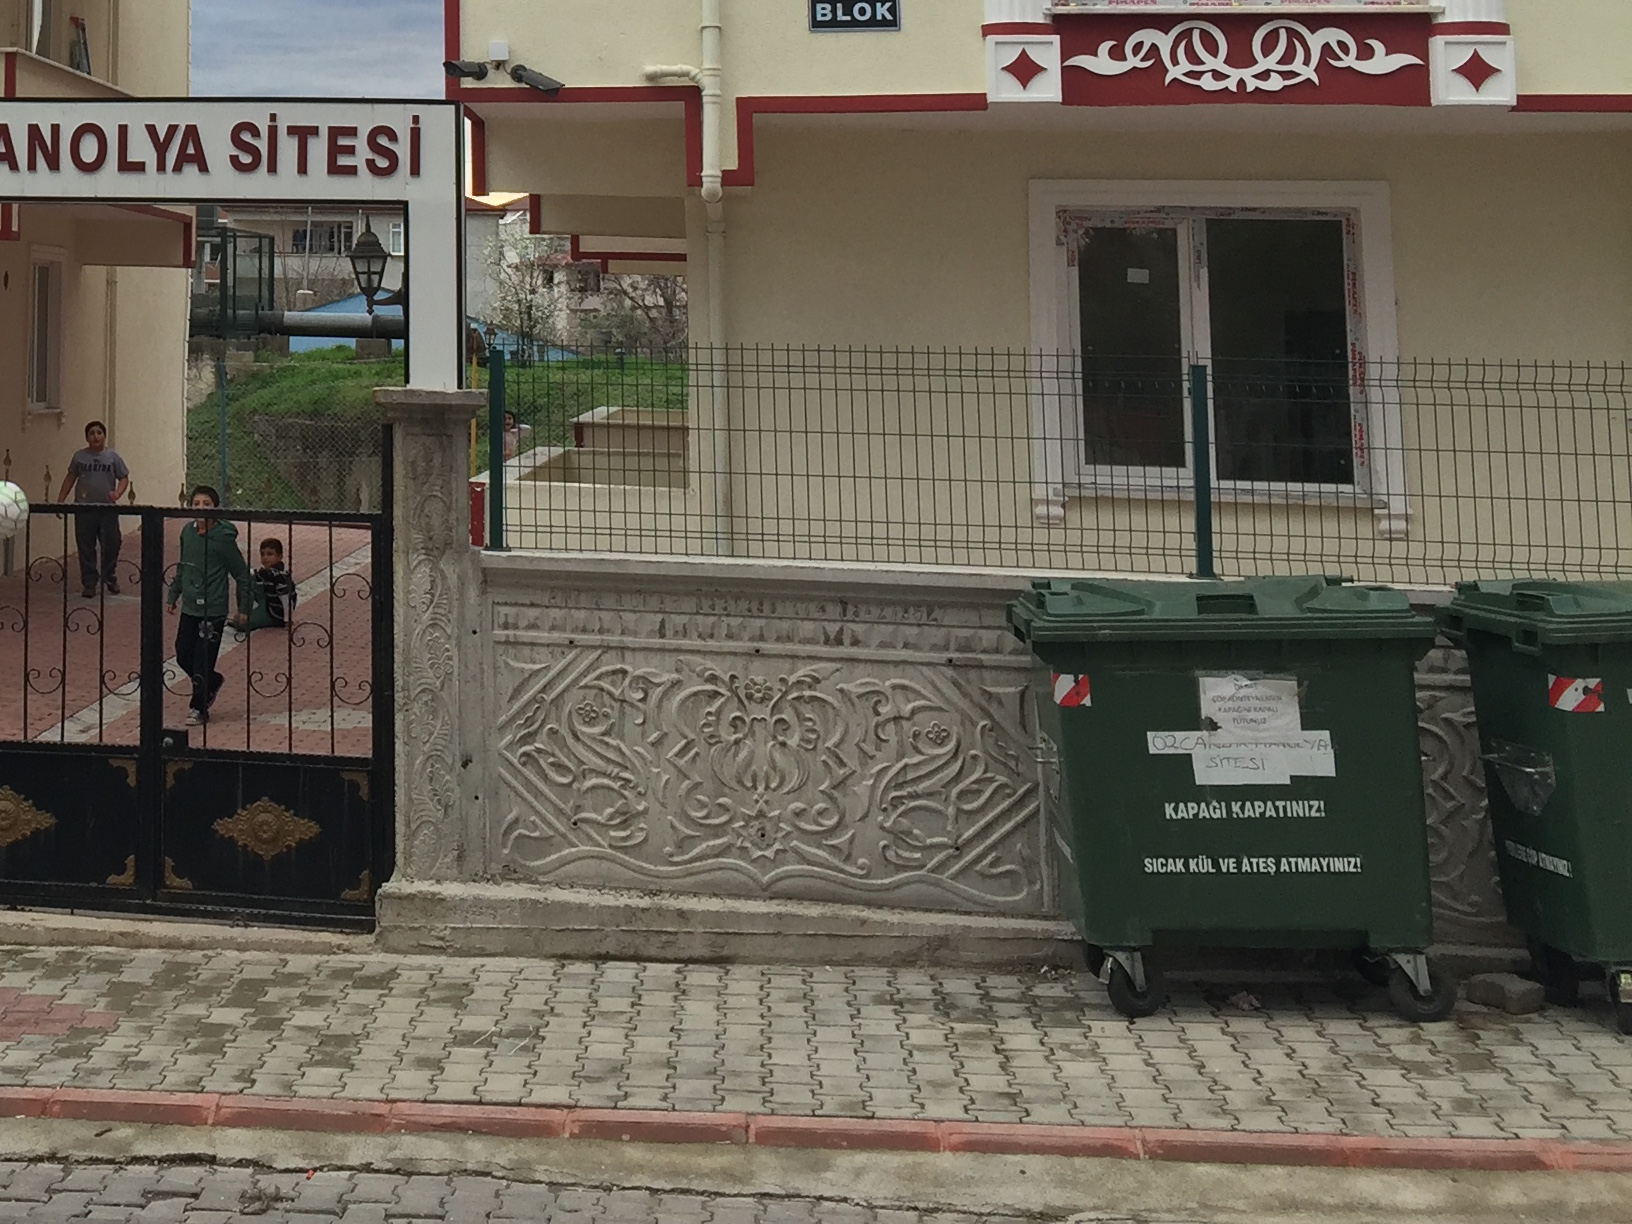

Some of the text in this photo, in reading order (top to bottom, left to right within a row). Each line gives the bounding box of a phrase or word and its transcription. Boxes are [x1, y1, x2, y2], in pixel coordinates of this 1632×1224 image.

[815, 2, 894, 21] BLOK
[228, 112, 422, 176] SİTESİ
[1164, 799, 1326, 820] KAPAĞI KAPATINIZ!
[1143, 855, 1362, 876] SICAK KÜL VE ATEŞ ATMAYINIZ!
